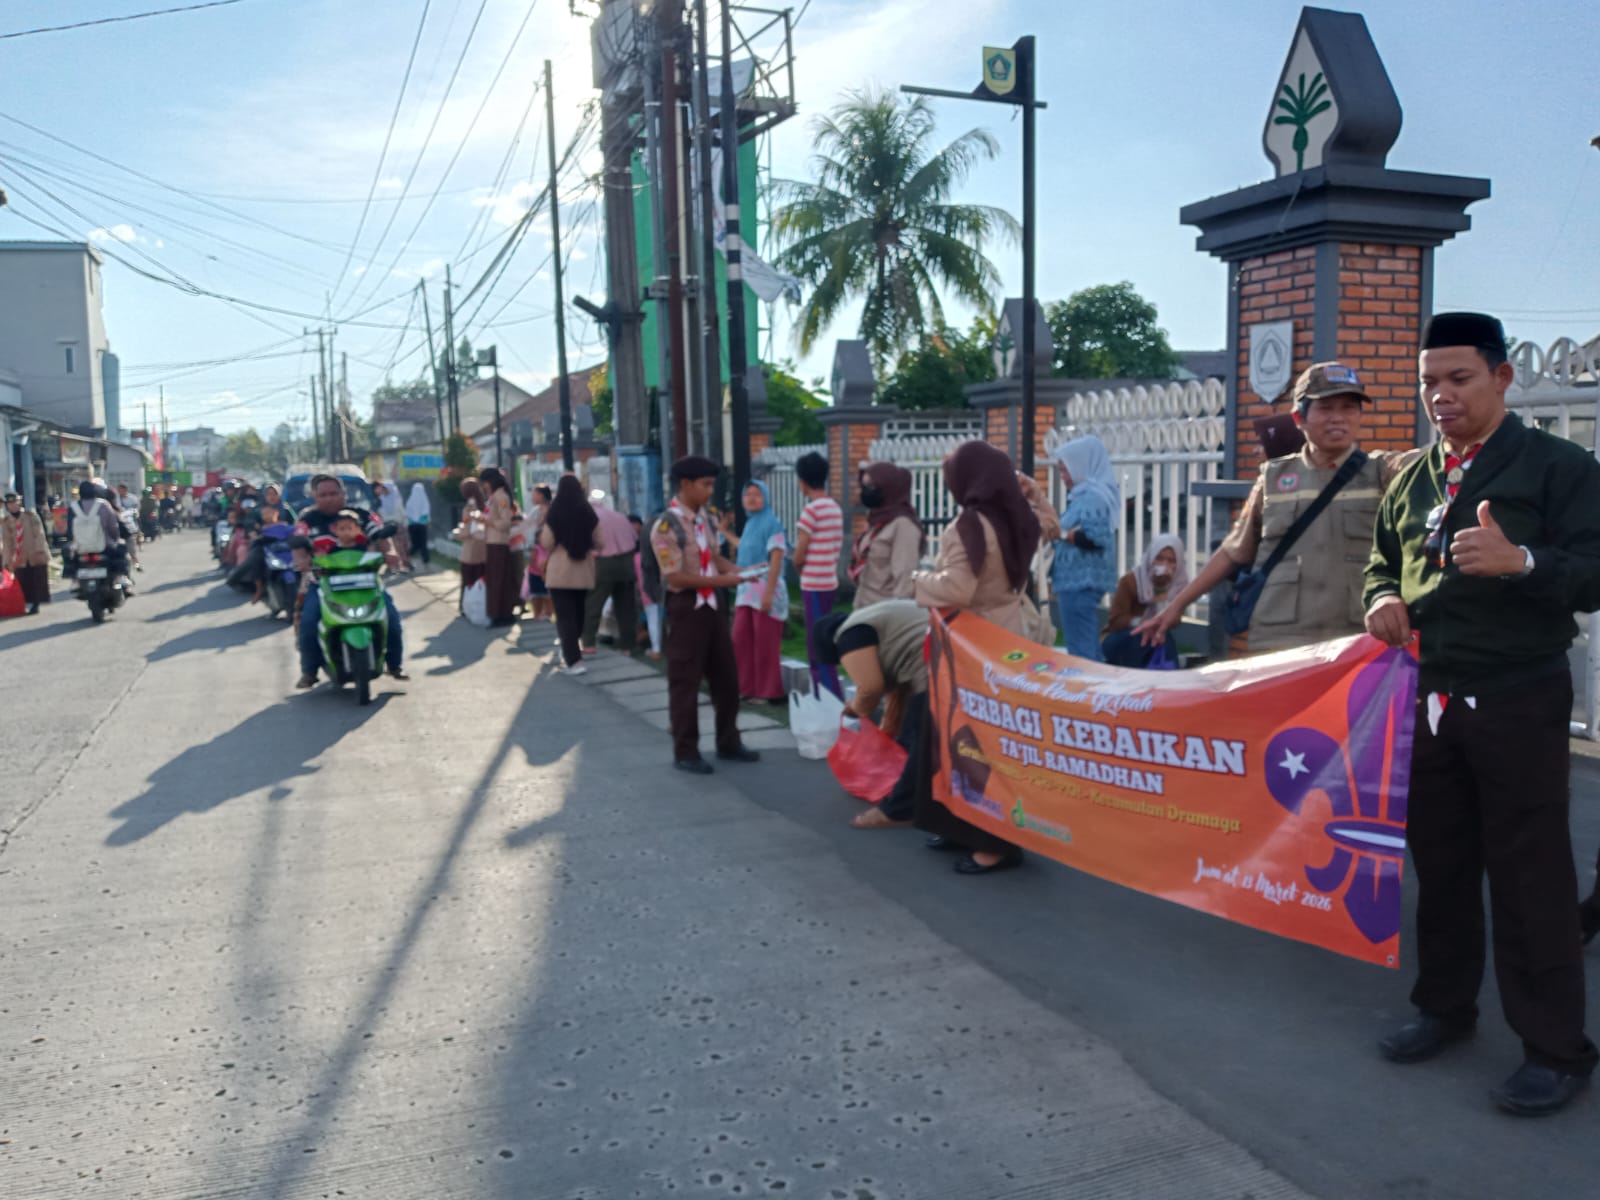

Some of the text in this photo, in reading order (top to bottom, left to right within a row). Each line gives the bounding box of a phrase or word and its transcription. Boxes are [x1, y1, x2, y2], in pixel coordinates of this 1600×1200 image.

[999, 736, 1043, 767] TA'JIL
[1043, 750, 1164, 796] RAMADHAN
[1051, 714, 1246, 776] KEBAIKAN
